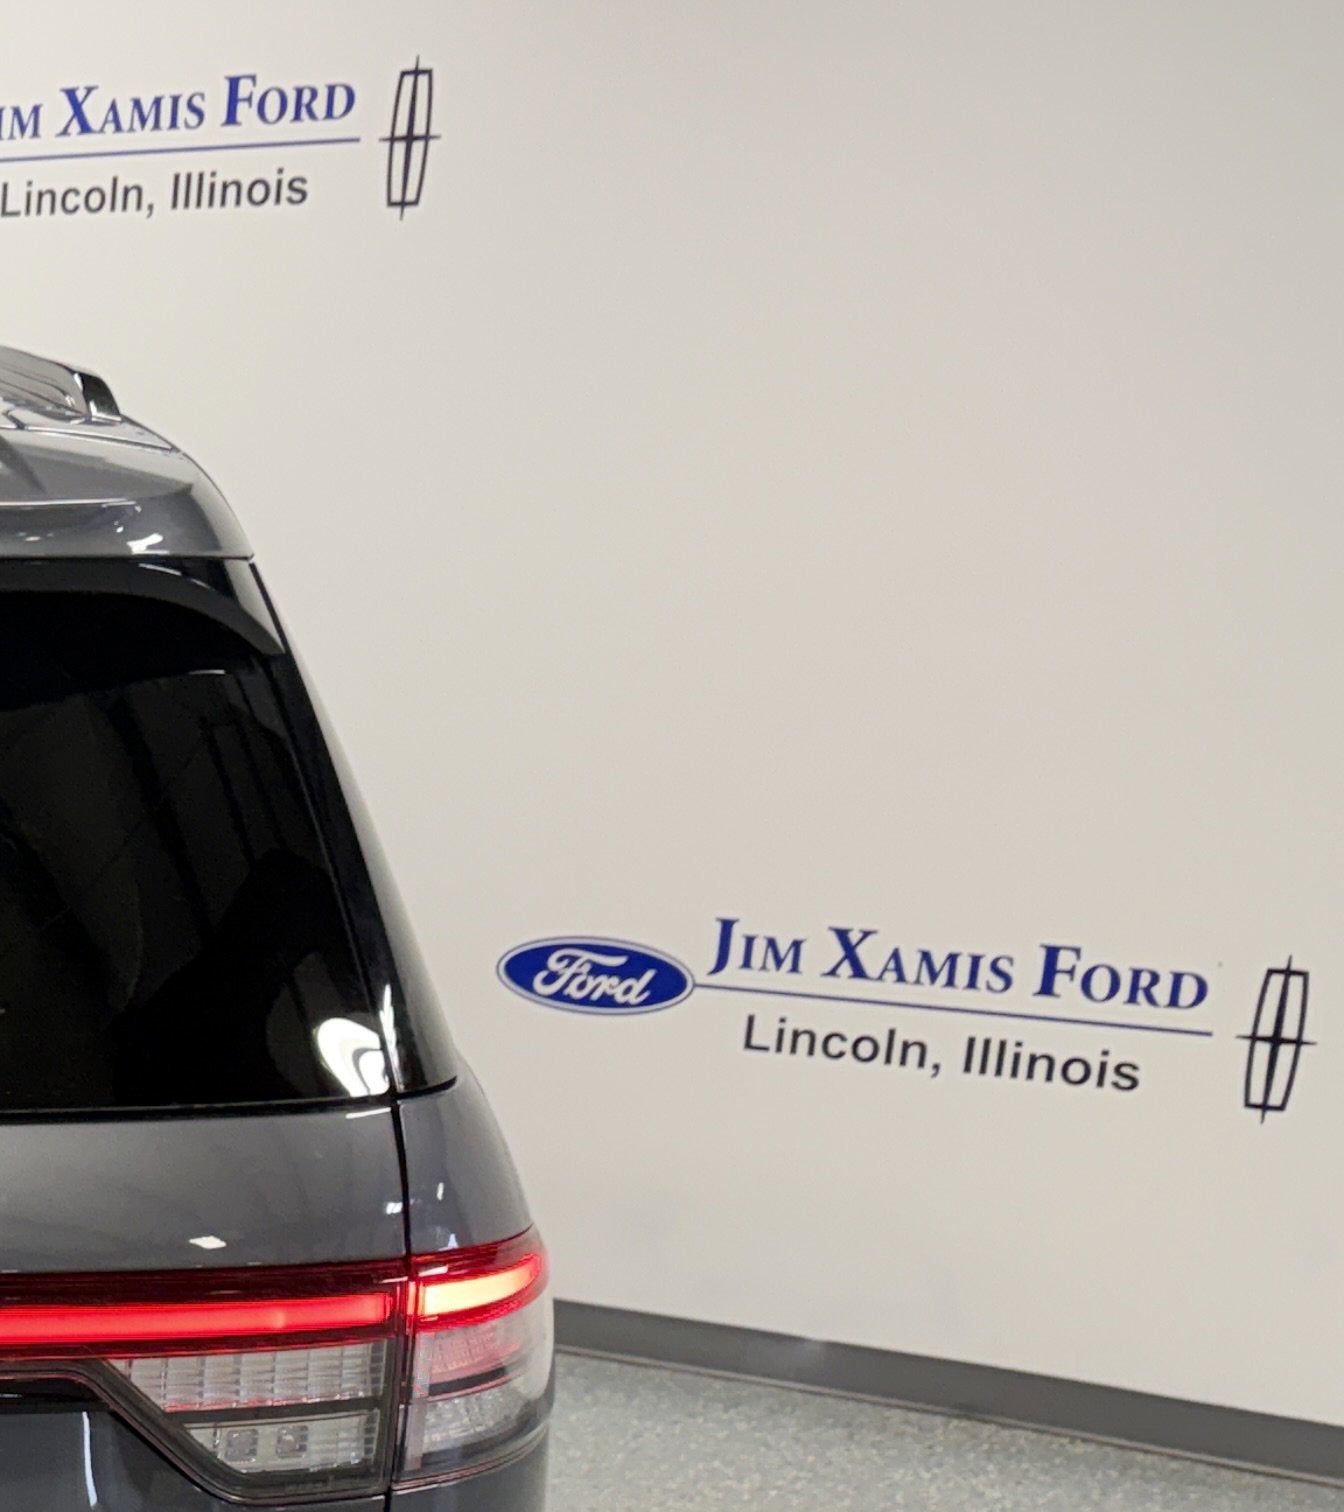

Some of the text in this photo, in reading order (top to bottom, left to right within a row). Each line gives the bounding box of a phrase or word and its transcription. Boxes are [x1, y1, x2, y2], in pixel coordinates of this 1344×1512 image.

[55, 85, 206, 138] XAMIS
[220, 73, 356, 128] FORD
[0, 167, 309, 219] Lincoln, Illinois
[531, 947, 651, 1006] Ford
[705, 917, 1210, 1011] JIM XAMIS FORD
[743, 1014, 1140, 1092] Lincoln, Illinois
